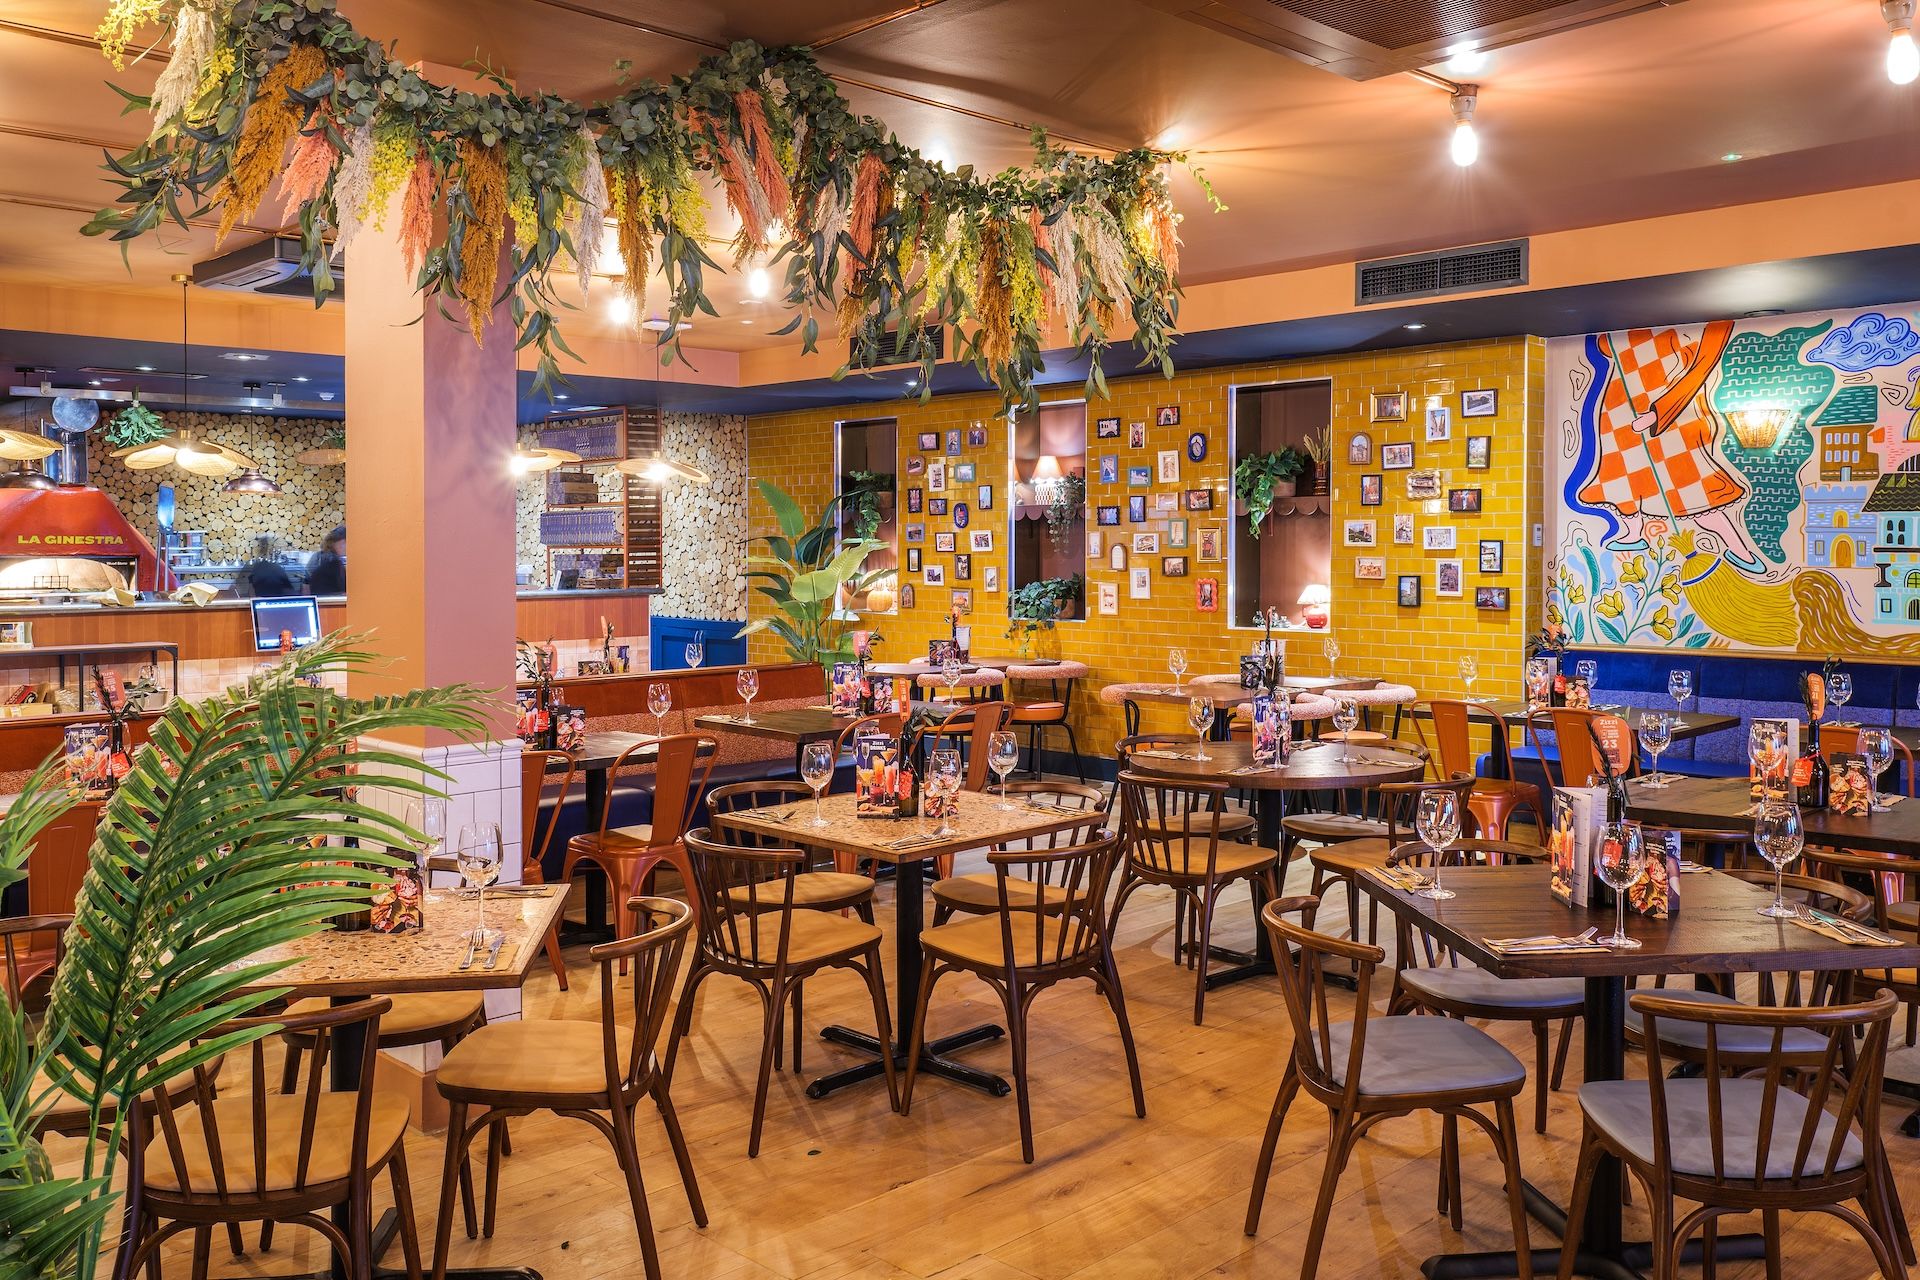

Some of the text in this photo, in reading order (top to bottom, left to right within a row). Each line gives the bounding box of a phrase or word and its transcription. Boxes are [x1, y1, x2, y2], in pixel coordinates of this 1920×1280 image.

[17, 535, 124, 544] LA GINESTRA
[1602, 739, 1618, 749] 23
